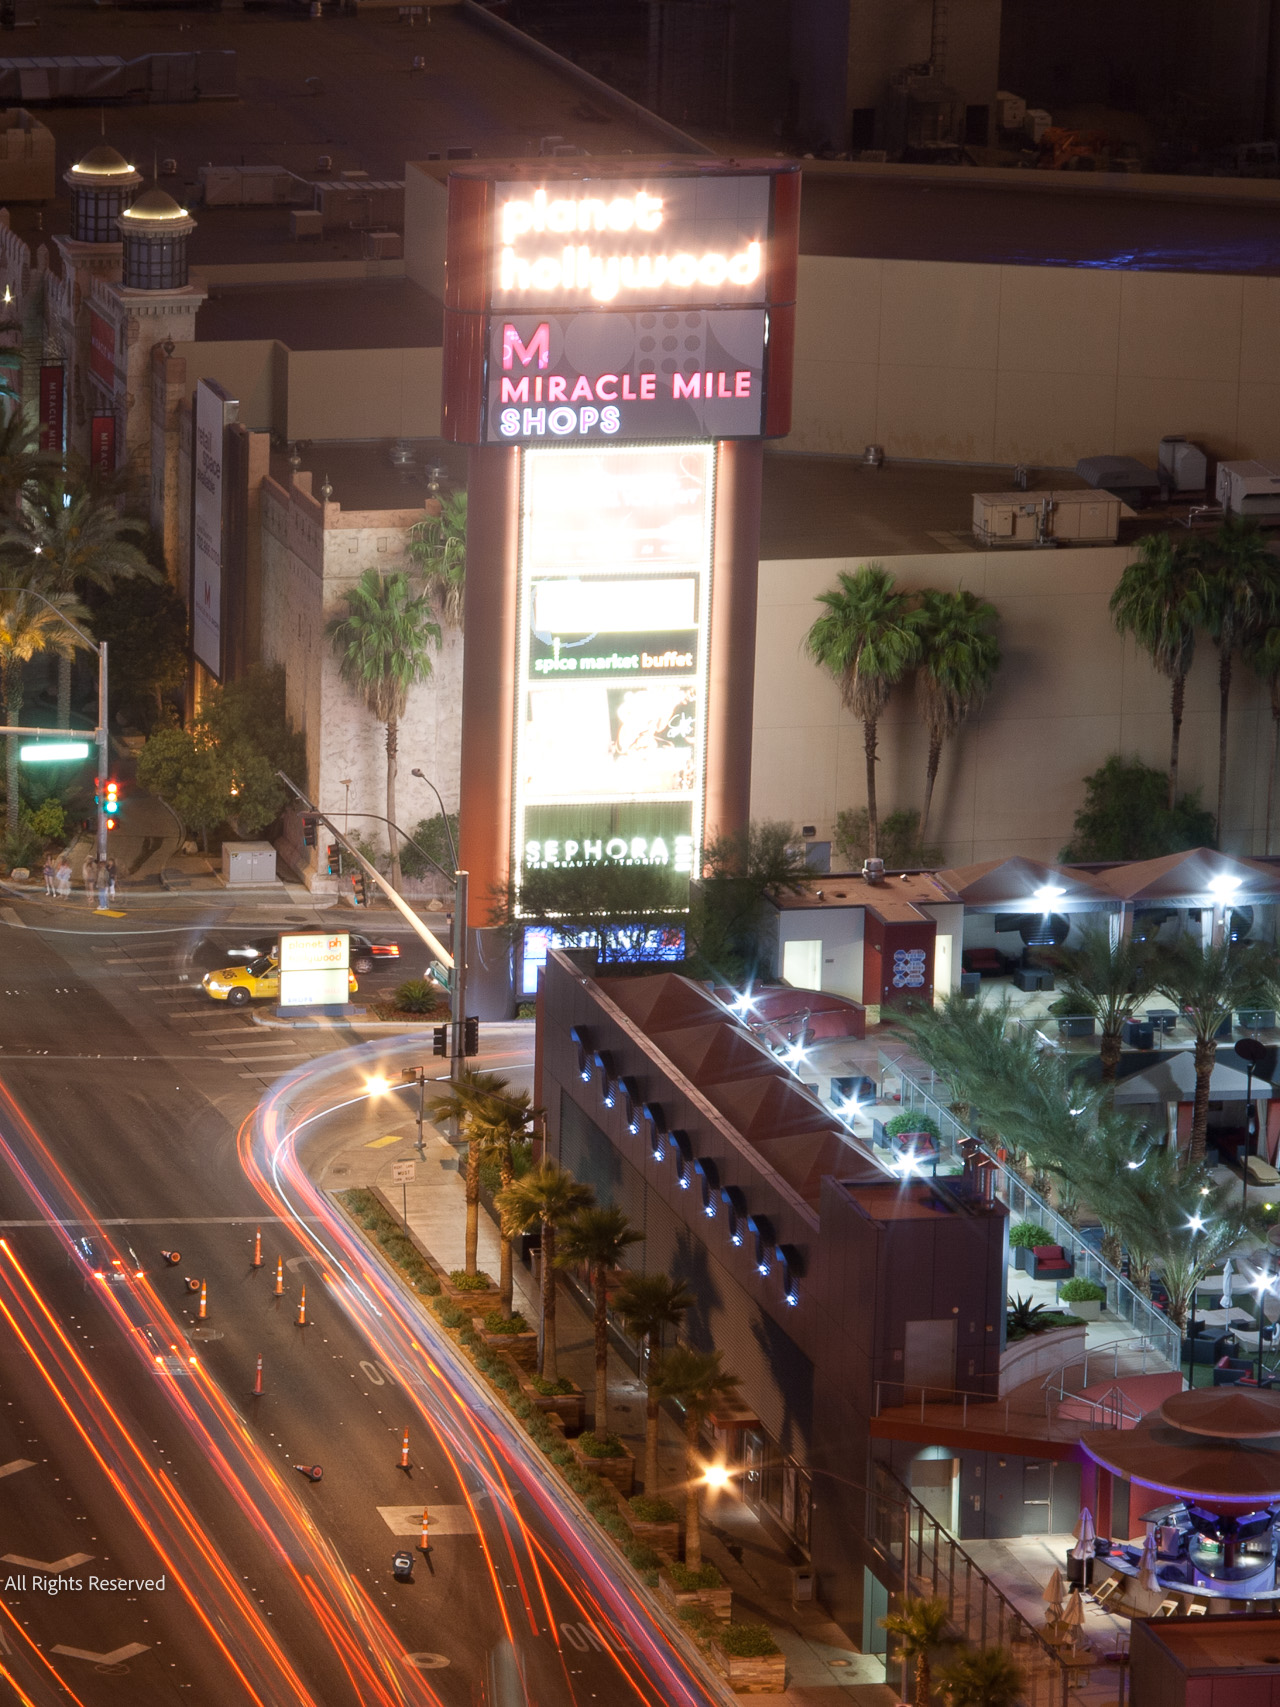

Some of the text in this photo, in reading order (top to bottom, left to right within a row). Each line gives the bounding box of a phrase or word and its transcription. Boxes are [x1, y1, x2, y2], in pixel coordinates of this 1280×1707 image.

[501, 188, 664, 246] planet
[500, 240, 761, 301] hollywood
[502, 323, 549, 370] M
[501, 371, 751, 403] MIRACLE MILE
[48, 382, 57, 425] MIRACLE
[500, 405, 621, 437] SHOPS
[197, 426, 212, 454] retail
[203, 450, 221, 479] space
[535, 640, 693, 674] spice market buffet
[525, 837, 669, 862] SEPHORA
[526, 856, 669, 869] THE BEAUTY ATHORITY
[289, 937, 342, 951] planet ph
